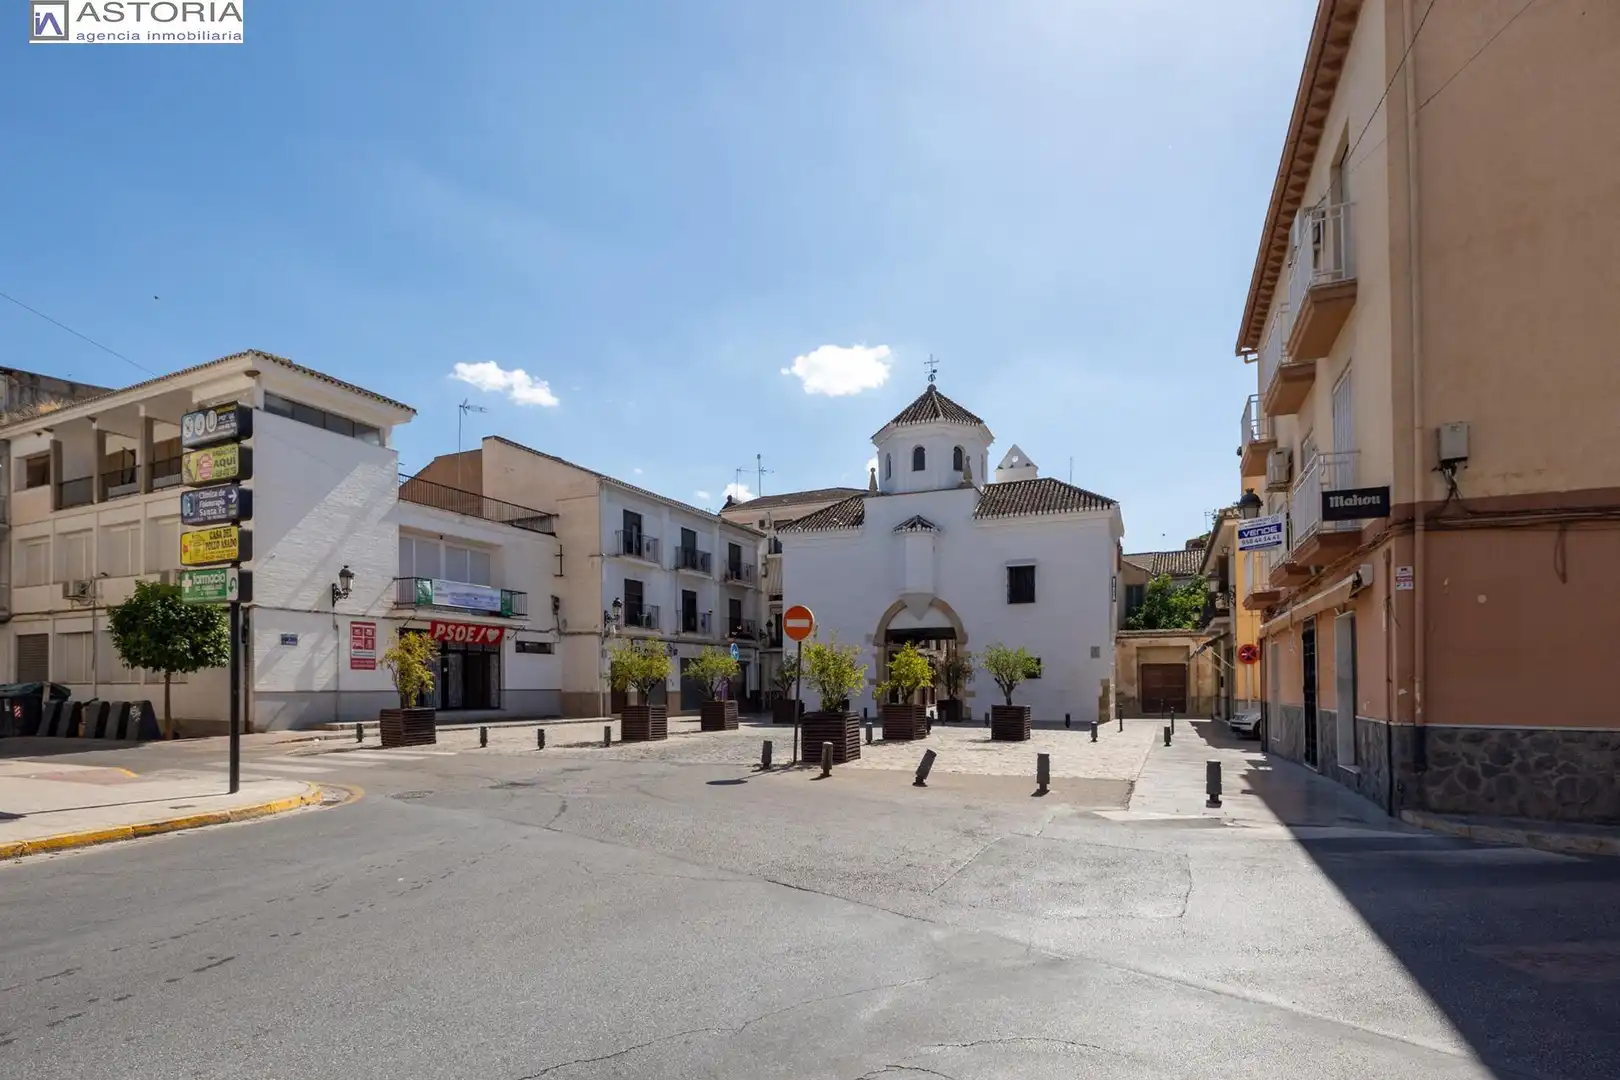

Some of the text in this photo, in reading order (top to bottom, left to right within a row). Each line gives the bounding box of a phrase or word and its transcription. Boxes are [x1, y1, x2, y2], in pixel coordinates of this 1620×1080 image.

[1329, 494, 1381, 508] Mahou
[199, 508, 217, 516] Santa
[1242, 526, 1278, 537] VENDE
[192, 572, 226, 585] farmacia
